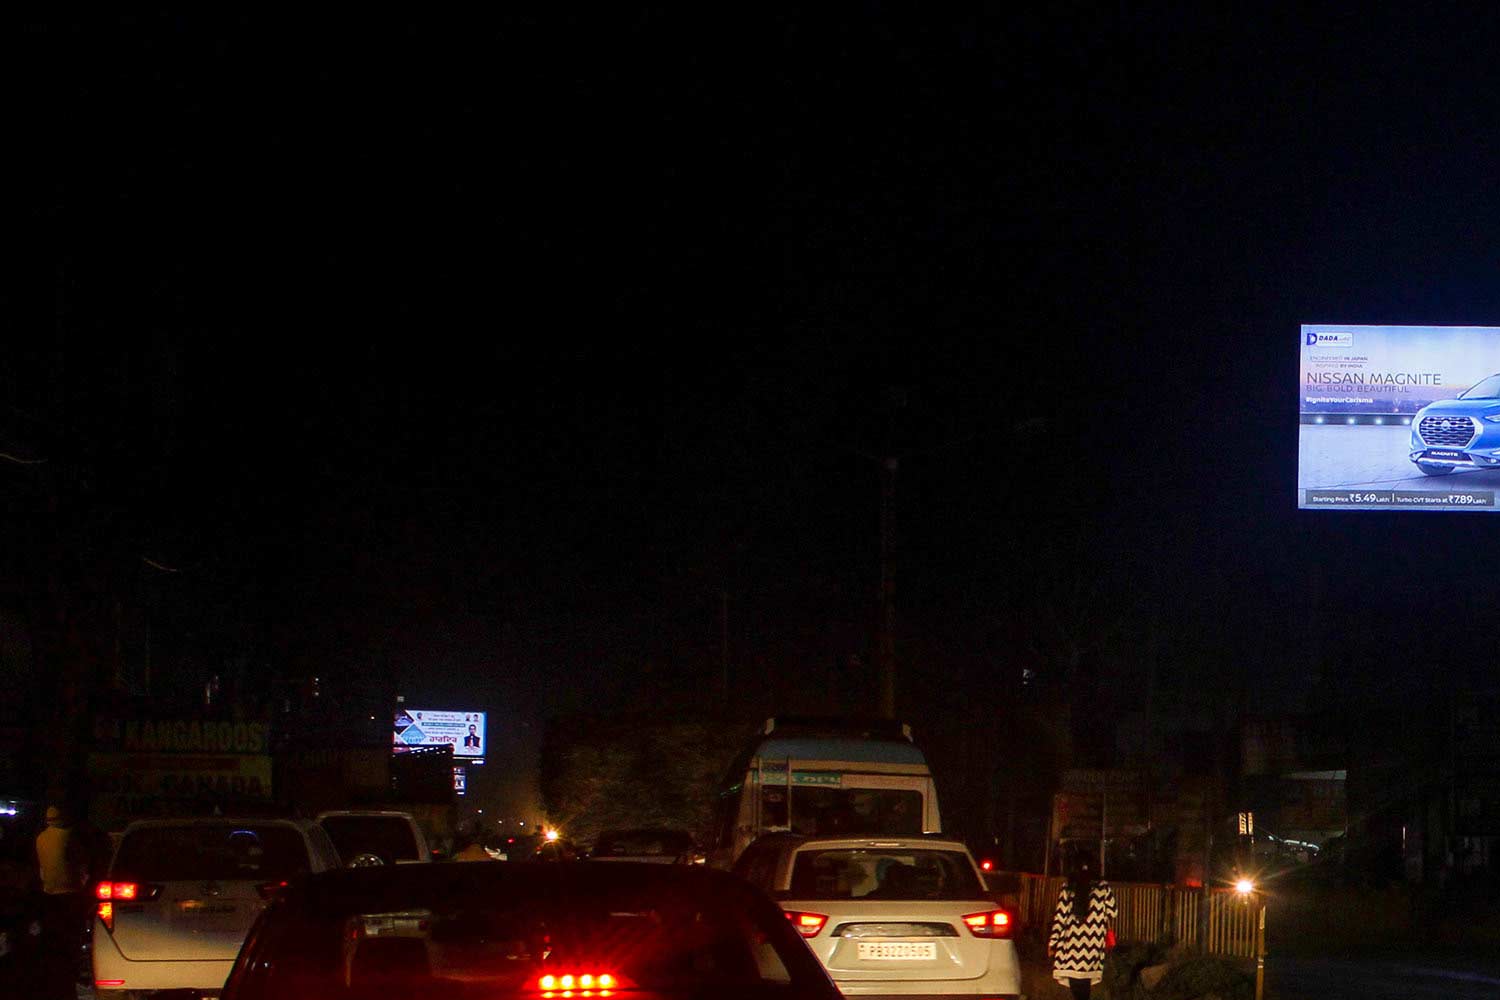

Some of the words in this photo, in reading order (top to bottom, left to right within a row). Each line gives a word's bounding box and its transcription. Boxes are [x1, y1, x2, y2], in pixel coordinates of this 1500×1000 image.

[1306, 372, 1364, 385] NISSAN
[1369, 373, 1441, 386] MAGNITE
[125, 720, 263, 751] KANGAROOS
